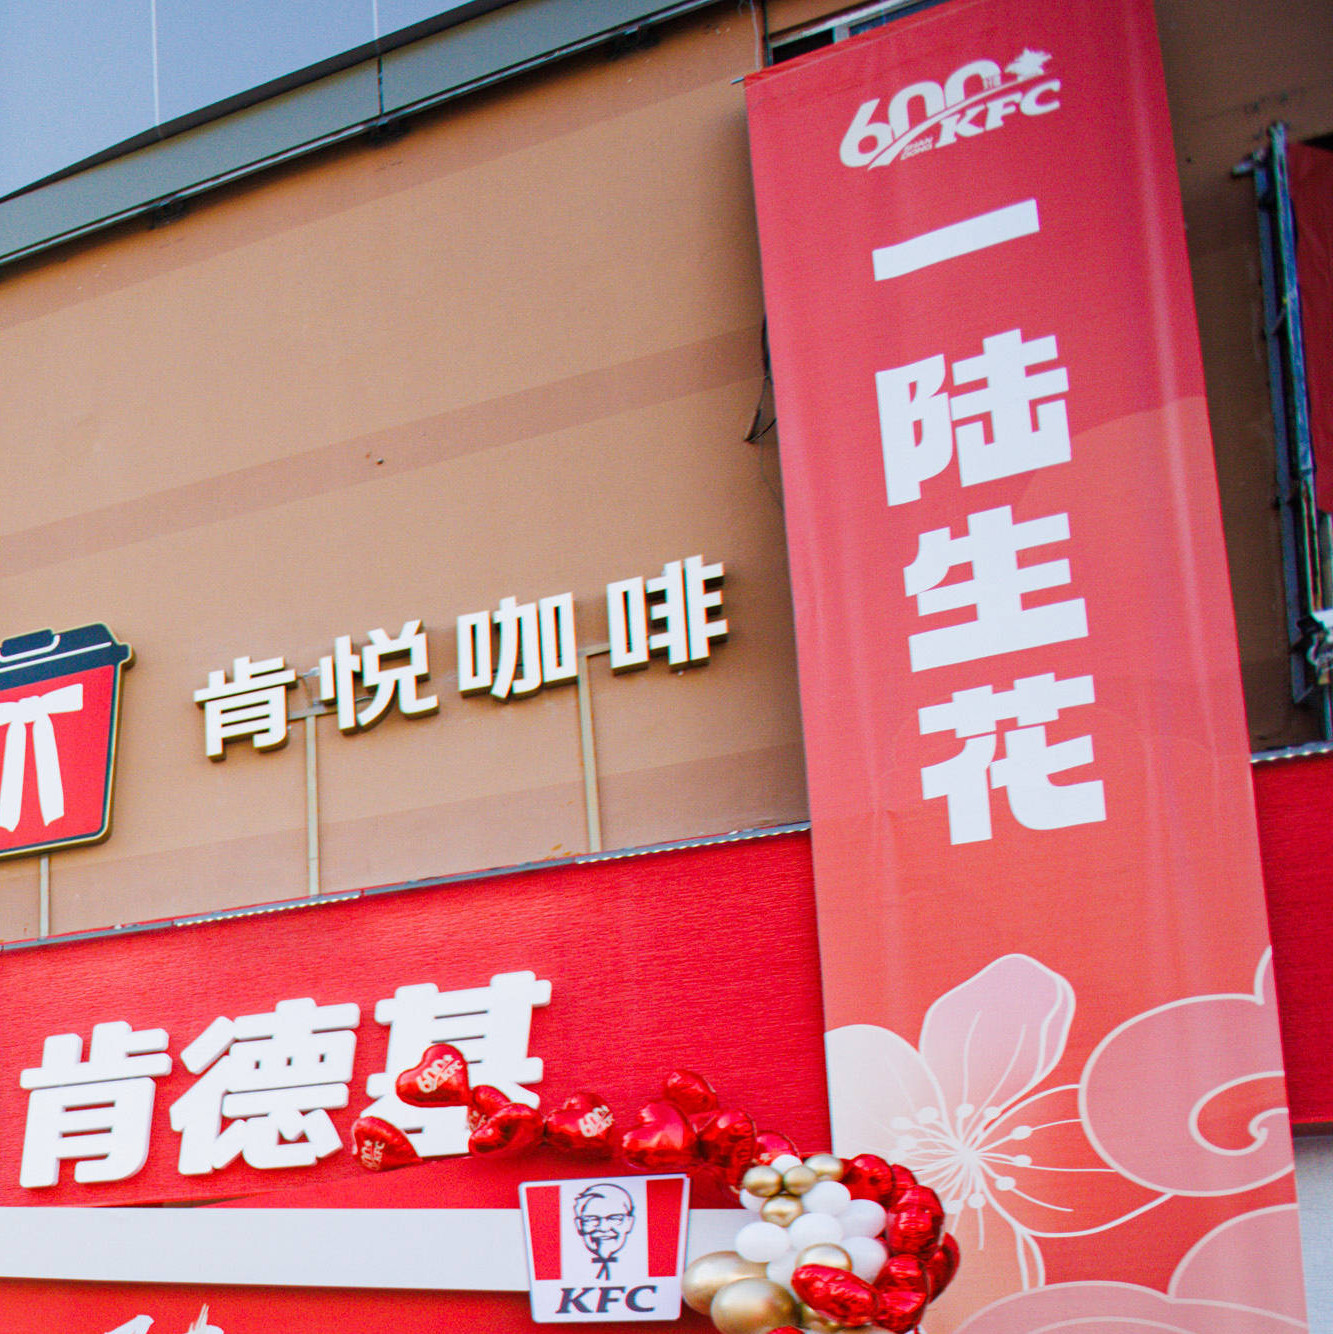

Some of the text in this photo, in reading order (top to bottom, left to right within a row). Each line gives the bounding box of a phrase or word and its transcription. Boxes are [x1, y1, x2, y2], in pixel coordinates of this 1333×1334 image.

[935, 79, 1061, 148] KFC
[872, 198, 1107, 846] 一陆生花
[193, 554, 728, 762] 肯悦咖啡
[19, 970, 552, 1188] 肯德基
[556, 1284, 657, 1314] KFC
